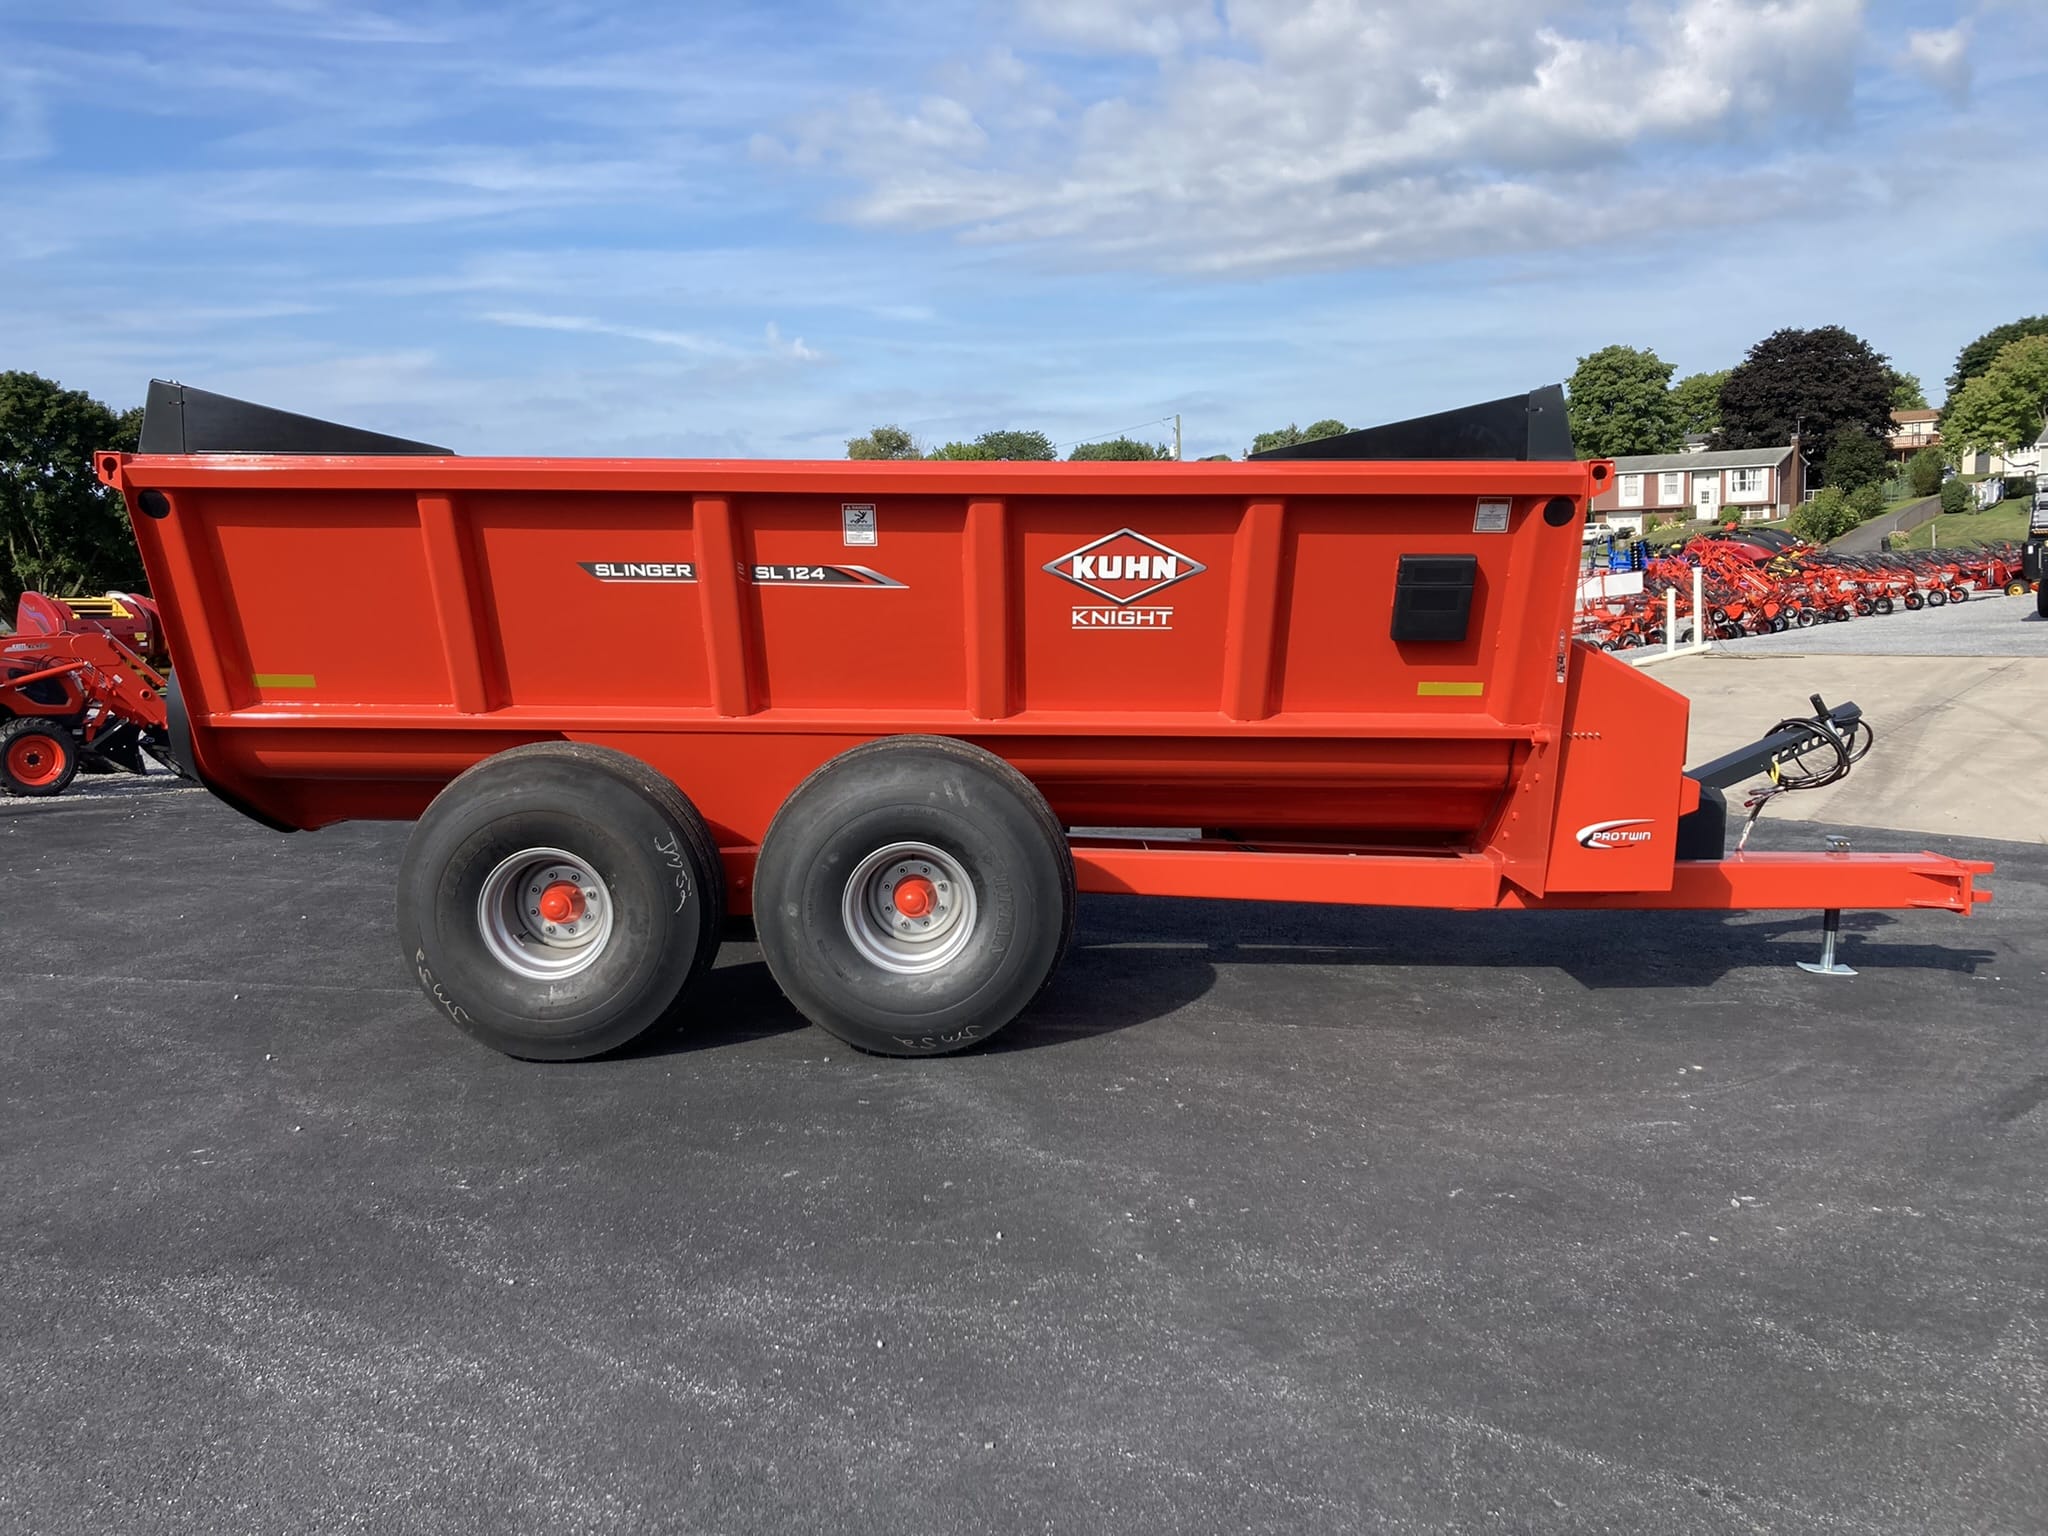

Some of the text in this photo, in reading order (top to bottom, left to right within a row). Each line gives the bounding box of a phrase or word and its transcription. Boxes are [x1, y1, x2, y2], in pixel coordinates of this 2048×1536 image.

[594, 563, 825, 580] SLINGER SL 124
[1072, 555, 1178, 580] KUHN
[1071, 610, 1173, 625] KNIGHT
[1592, 831, 1652, 841] PROTWIN
